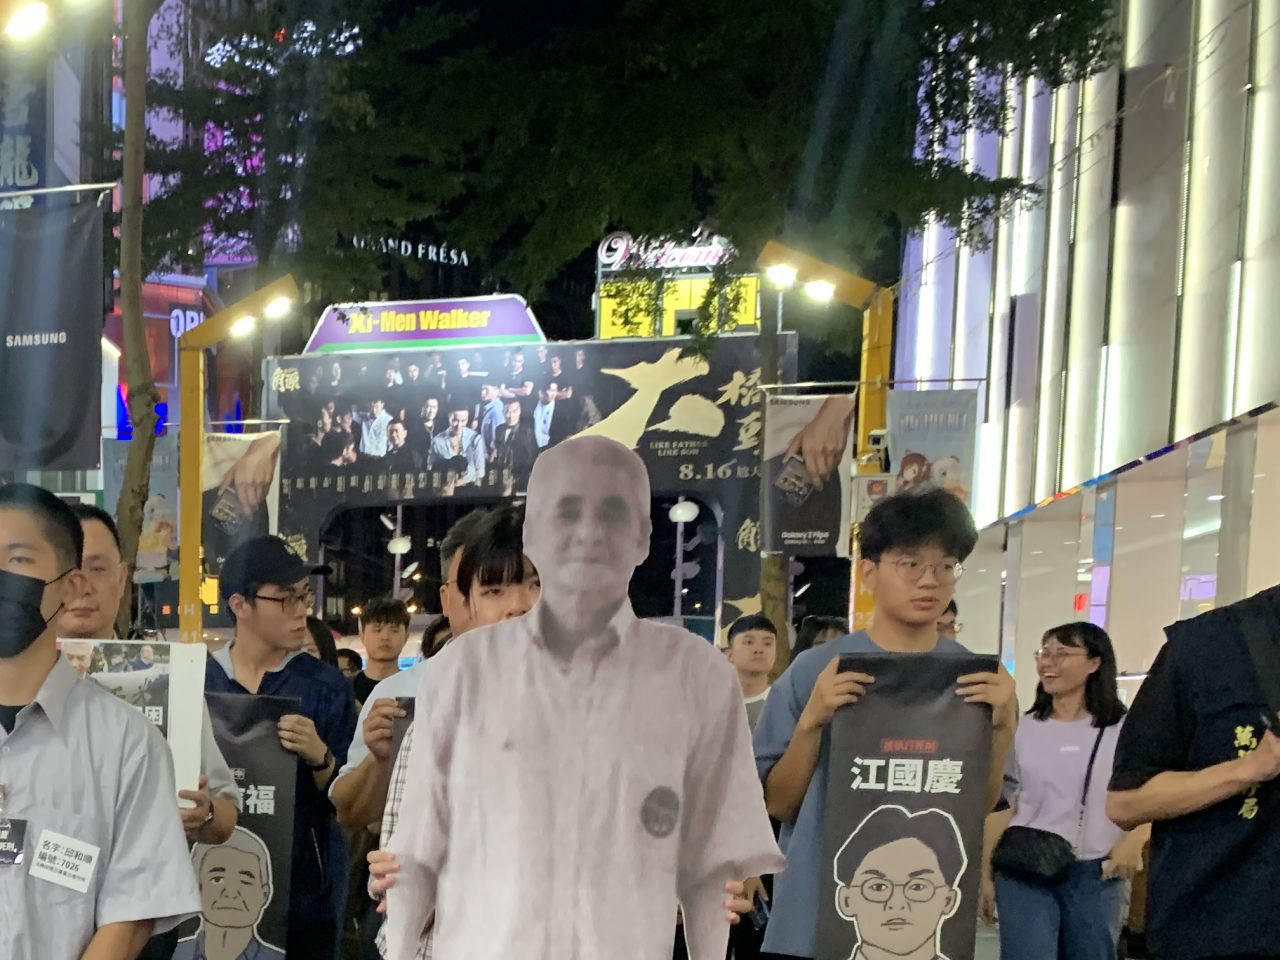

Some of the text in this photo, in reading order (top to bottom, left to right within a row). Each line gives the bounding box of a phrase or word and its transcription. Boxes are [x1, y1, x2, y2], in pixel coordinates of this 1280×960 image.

[348, 308, 490, 334] Xi-Men Walker
[6, 331, 66, 347] SAMSUNG
[678, 458, 737, 480] 8.16
[850, 756, 963, 794] 江國慶
